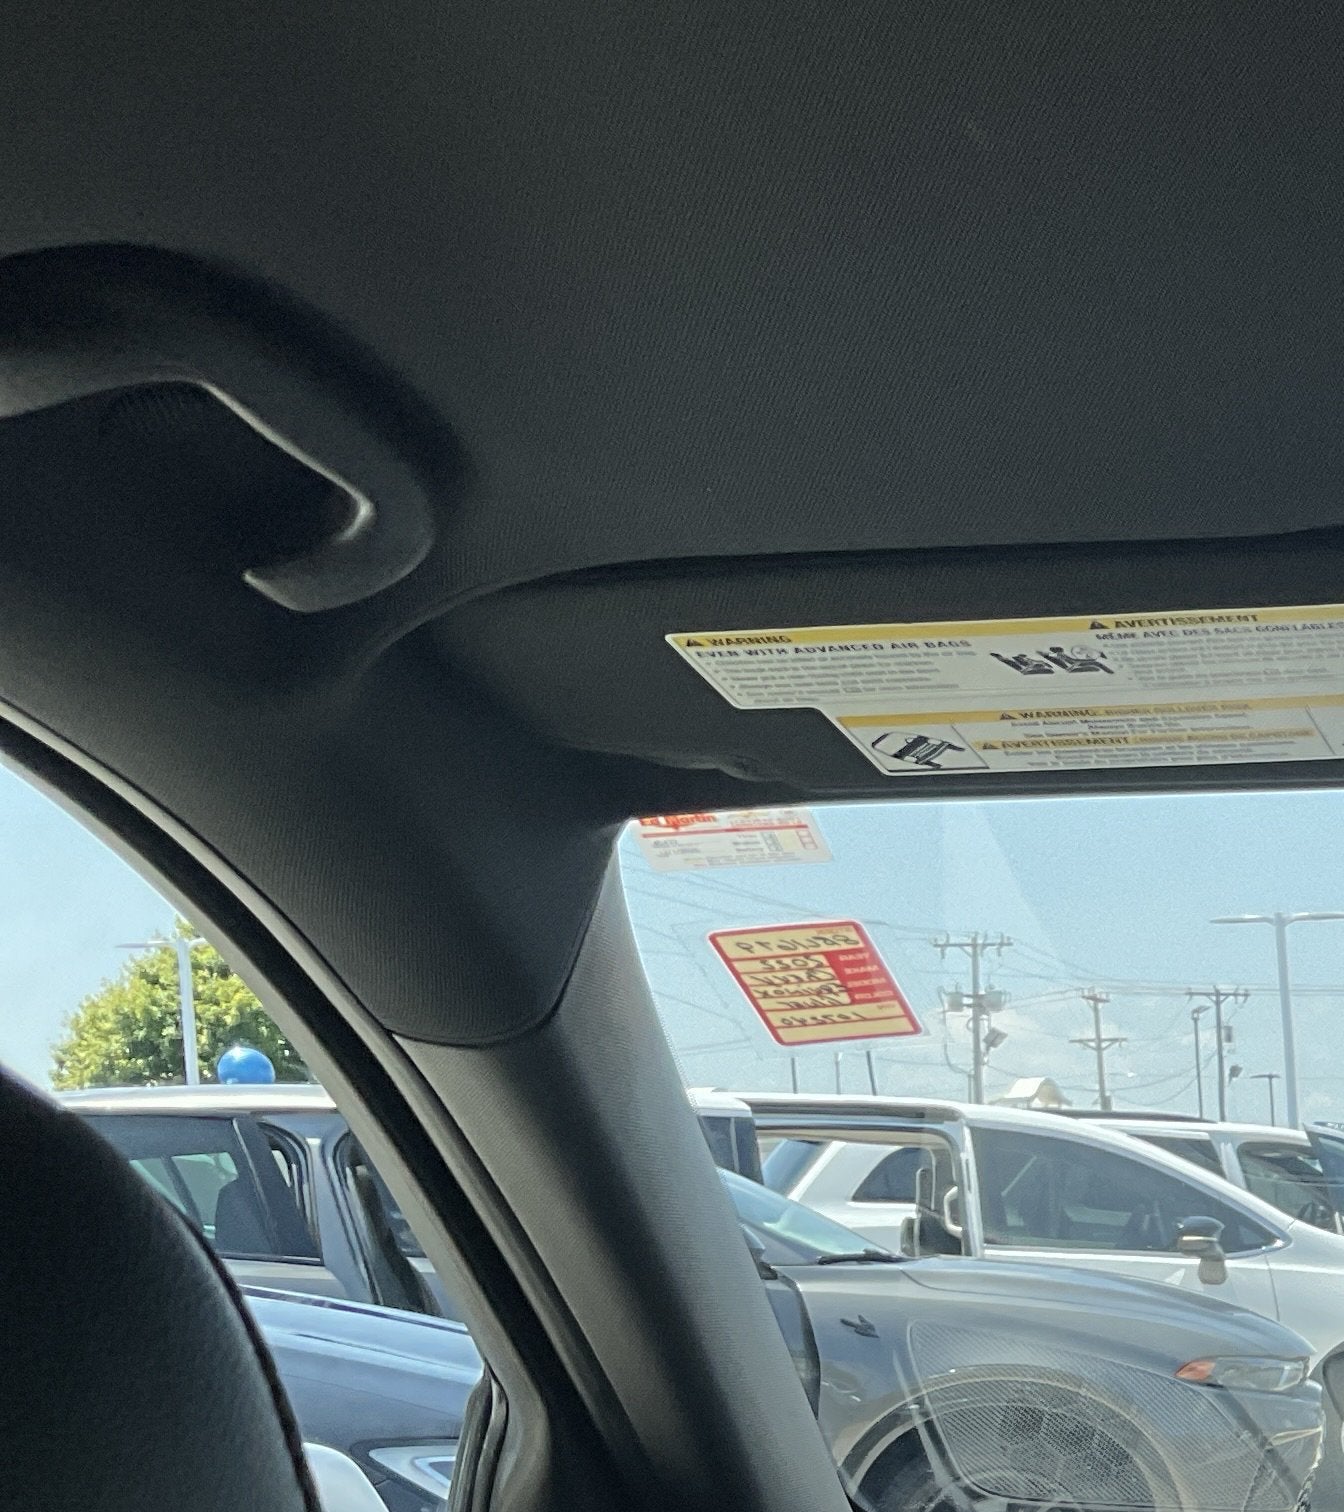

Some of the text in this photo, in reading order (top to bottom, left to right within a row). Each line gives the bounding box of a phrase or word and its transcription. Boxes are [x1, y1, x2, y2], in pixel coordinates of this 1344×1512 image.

[1114, 614, 1259, 629] AVERTISSEMENT
[708, 635, 792, 647] WARNING
[743, 647, 790, 657] WITH
[794, 643, 884, 654] ADVANCED
[890, 642, 919, 650] AIR
[925, 640, 972, 649] BAGS
